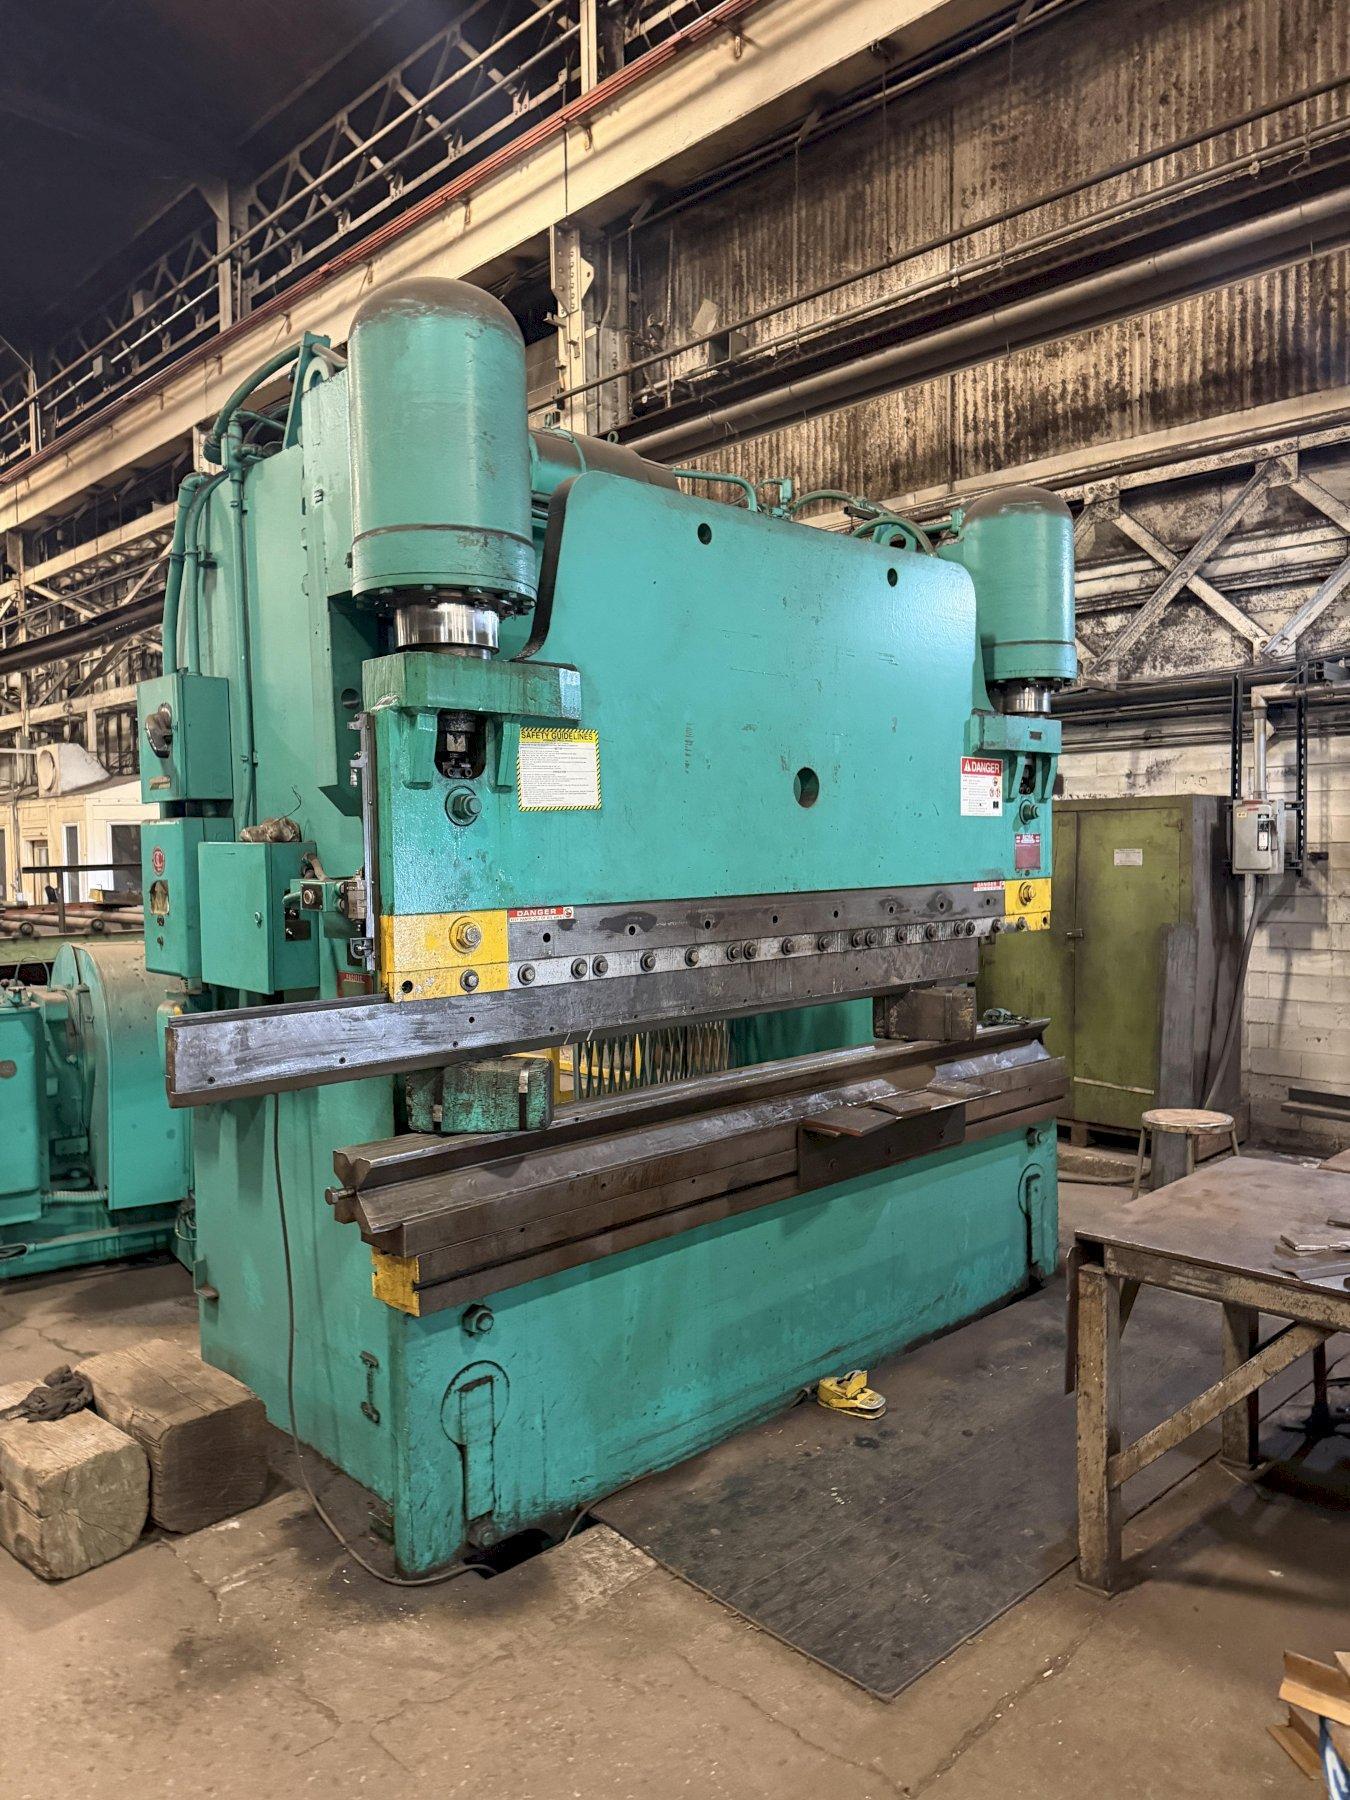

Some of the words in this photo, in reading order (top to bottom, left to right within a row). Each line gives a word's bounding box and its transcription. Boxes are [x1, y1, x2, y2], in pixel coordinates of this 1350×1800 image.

[521, 731, 549, 740] SAFETY
[551, 732, 593, 741] GUIDELINES
[971, 761, 1000, 774] DANGER
[516, 908, 557, 917] DANGER
